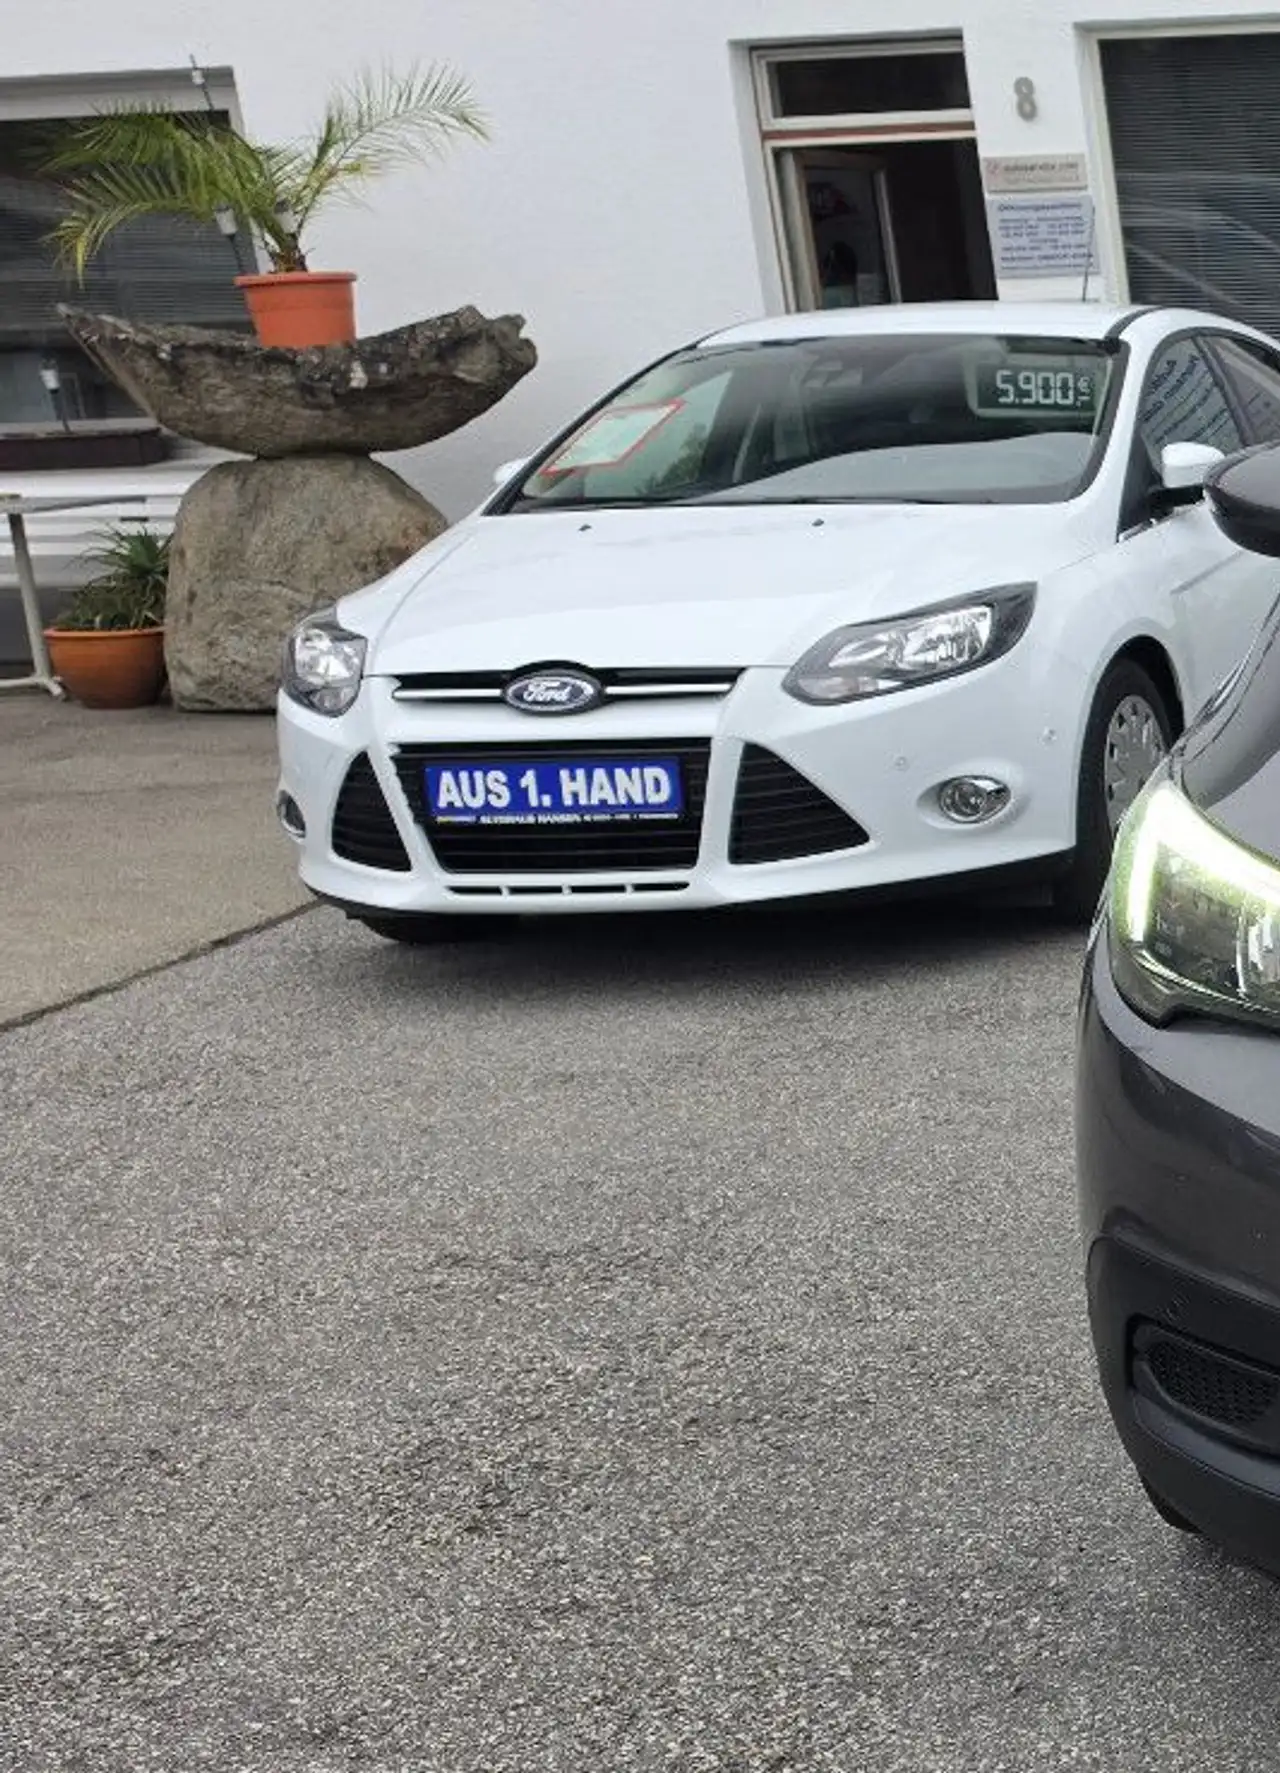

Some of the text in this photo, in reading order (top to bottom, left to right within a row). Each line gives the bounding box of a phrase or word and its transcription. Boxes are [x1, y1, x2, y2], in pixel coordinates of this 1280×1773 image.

[1014, 77, 1038, 121] 8
[437, 767, 671, 808] AUS 1. HAND
